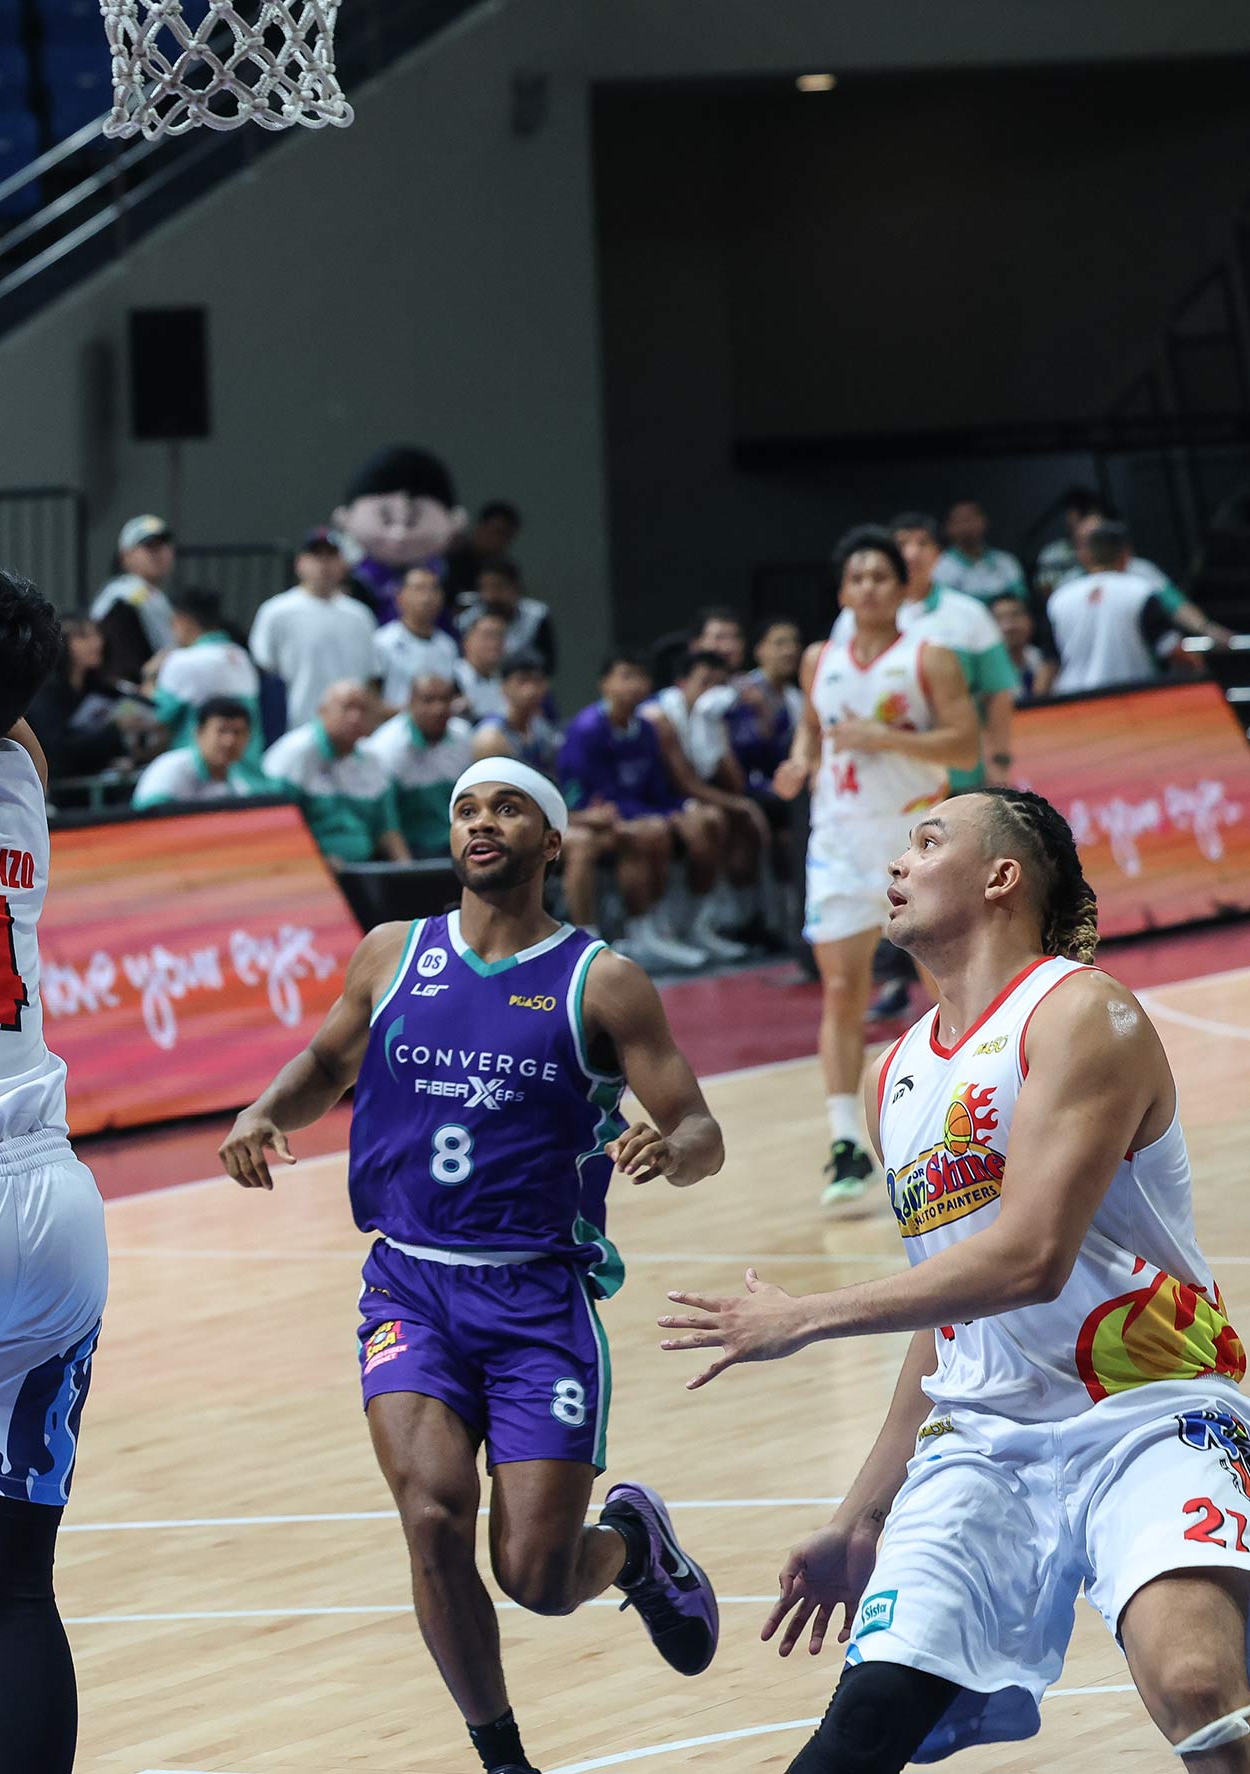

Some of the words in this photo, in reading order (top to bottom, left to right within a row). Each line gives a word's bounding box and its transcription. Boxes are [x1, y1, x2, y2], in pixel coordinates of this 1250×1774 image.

[422, 954, 442, 970] DS
[40, 950, 120, 1017] ove
[395, 1044, 559, 1083] CONVERGE
[430, 1122, 476, 1186] 8
[936, 1184, 998, 1215] PAINTERS
[550, 1377, 588, 1428] 8
[865, 1602, 887, 1621] Sista
